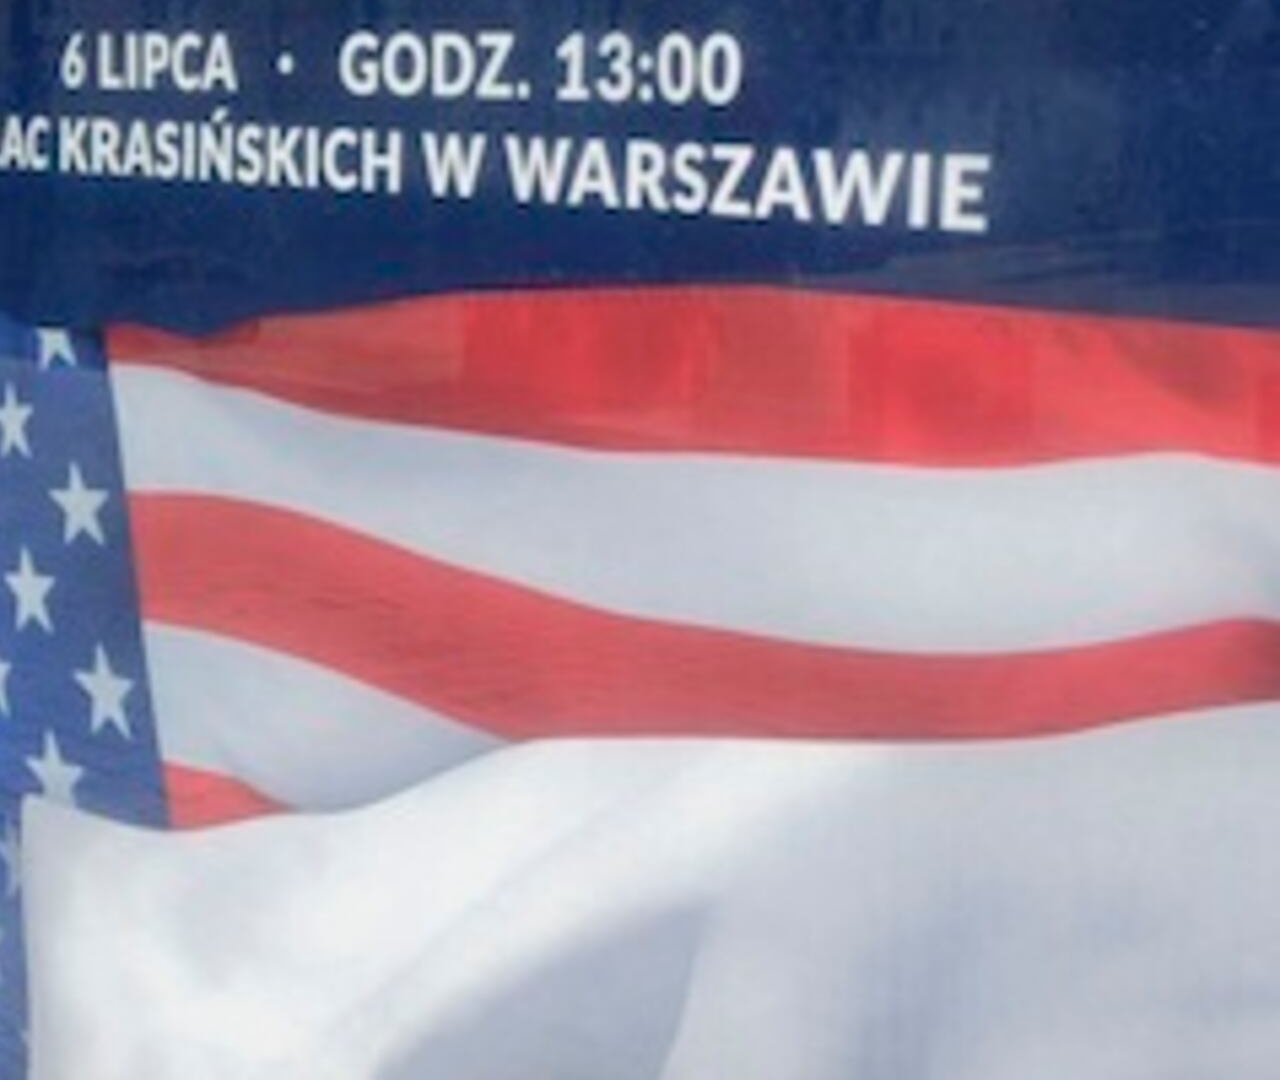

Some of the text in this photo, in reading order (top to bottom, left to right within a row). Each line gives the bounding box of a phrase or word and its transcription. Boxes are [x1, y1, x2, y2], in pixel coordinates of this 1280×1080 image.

[60, 30, 743, 106] 6 LIPCA GODZ. 13:00
[58, 106, 404, 195] KRASIŃSKICH
[421, 131, 487, 199] W
[503, 133, 992, 233] WARSZAWIE
